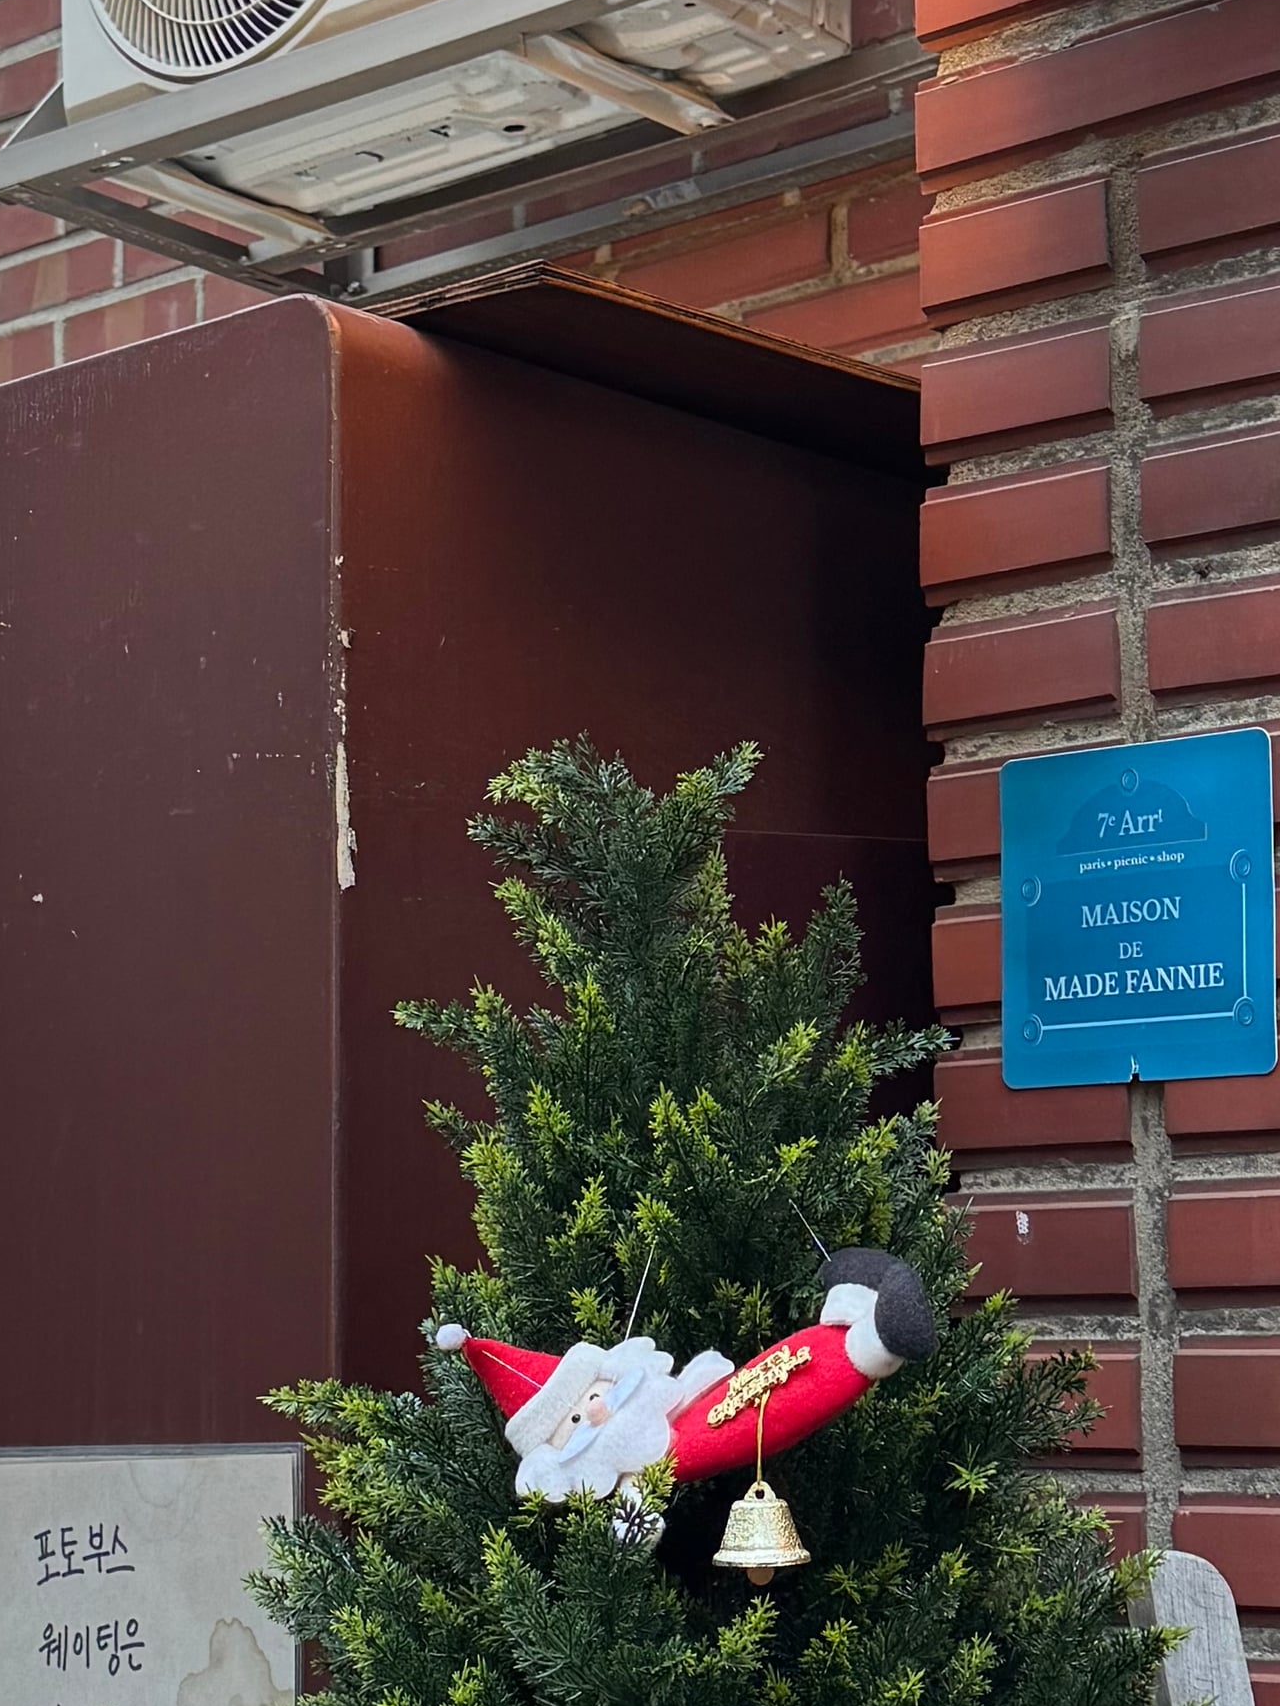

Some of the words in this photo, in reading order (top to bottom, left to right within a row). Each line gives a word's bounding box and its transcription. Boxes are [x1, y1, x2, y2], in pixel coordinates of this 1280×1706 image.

[1114, 853, 1148, 870] picnic
[1156, 850, 1185, 864] shop
[1080, 895, 1182, 929] MAISON
[1119, 941, 1143, 960] DE
[1044, 970, 1120, 1002] MADE
[1124, 961, 1225, 994] FANNIE
[34, 1523, 135, 1585] 포토부스
[39, 1618, 145, 1675] 웨이팅은
